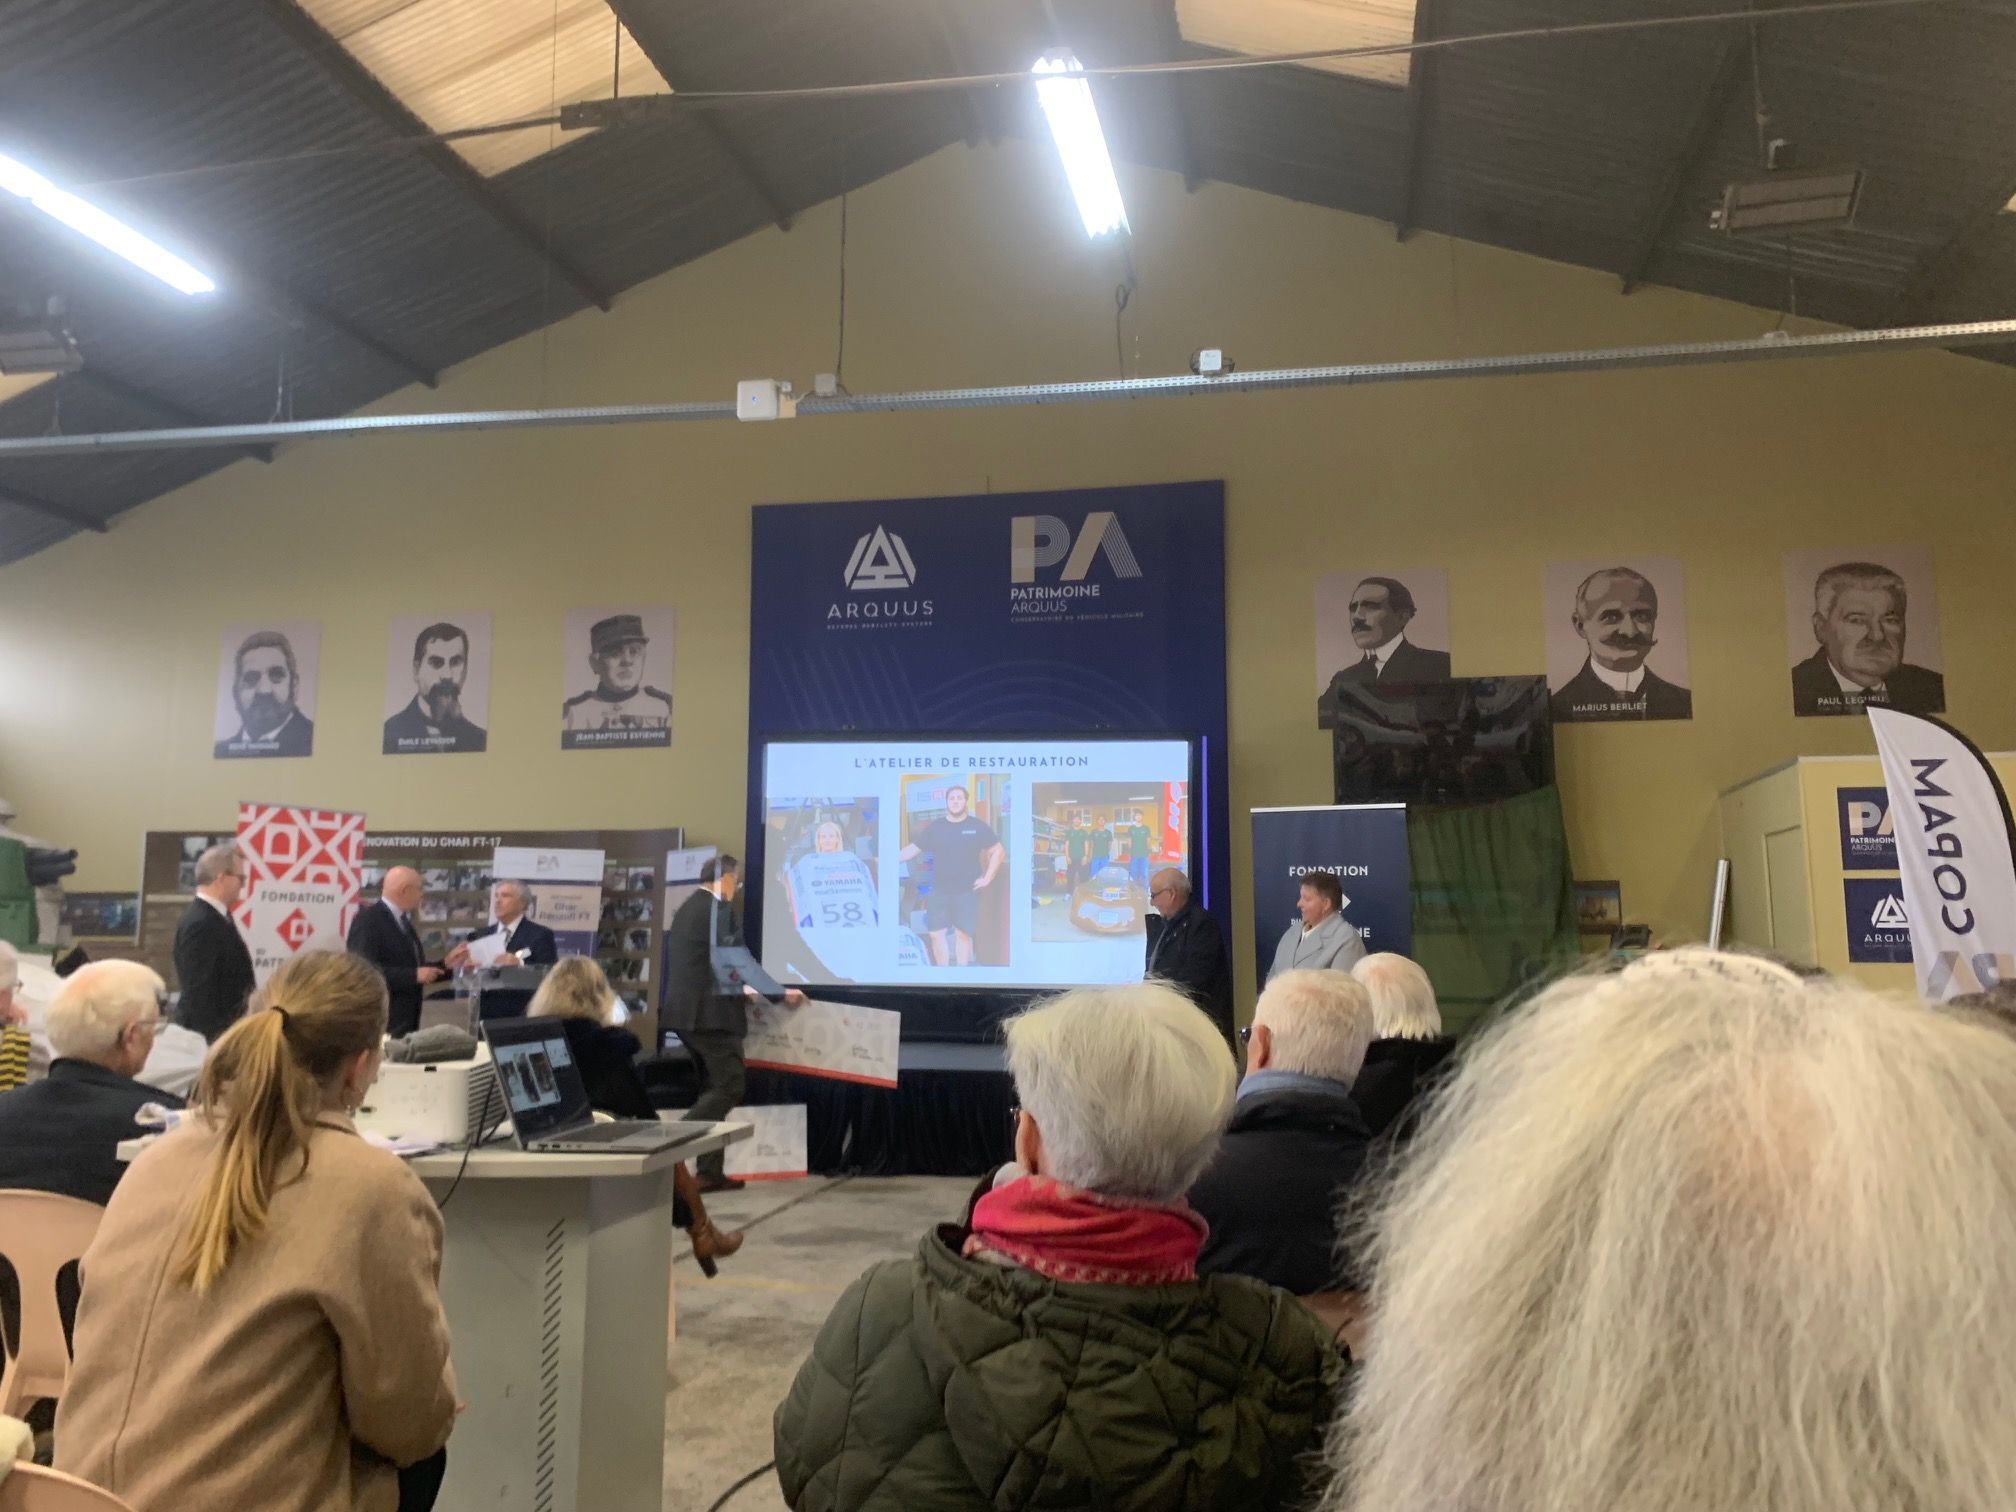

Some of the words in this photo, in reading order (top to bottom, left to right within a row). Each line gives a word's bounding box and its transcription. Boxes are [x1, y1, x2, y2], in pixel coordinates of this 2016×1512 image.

[1010, 584, 1101, 600] PATRIMOINE
[826, 599, 934, 619] ARQUUS
[1010, 600, 1068, 615] ARQUUS
[1572, 703, 1609, 712] MARIUS
[1610, 702, 1648, 711] BERLIET
[1817, 697, 1842, 706] PAUL
[854, 757, 932, 769] L'ATELIER
[941, 757, 960, 768] DE
[968, 756, 1089, 768] RESTAURATION
[366, 837, 420, 848] NOVATION
[422, 836, 438, 847] DU
[440, 836, 471, 848] CHAR
[473, 836, 502, 848] FT-17
[1850, 836, 1896, 845] PATRIMOIN
[824, 879, 862, 887] YAMAHA
[261, 890, 335, 904] FONDATION
[821, 902, 865, 924] 58
[1864, 934, 1913, 943] ARQUU
